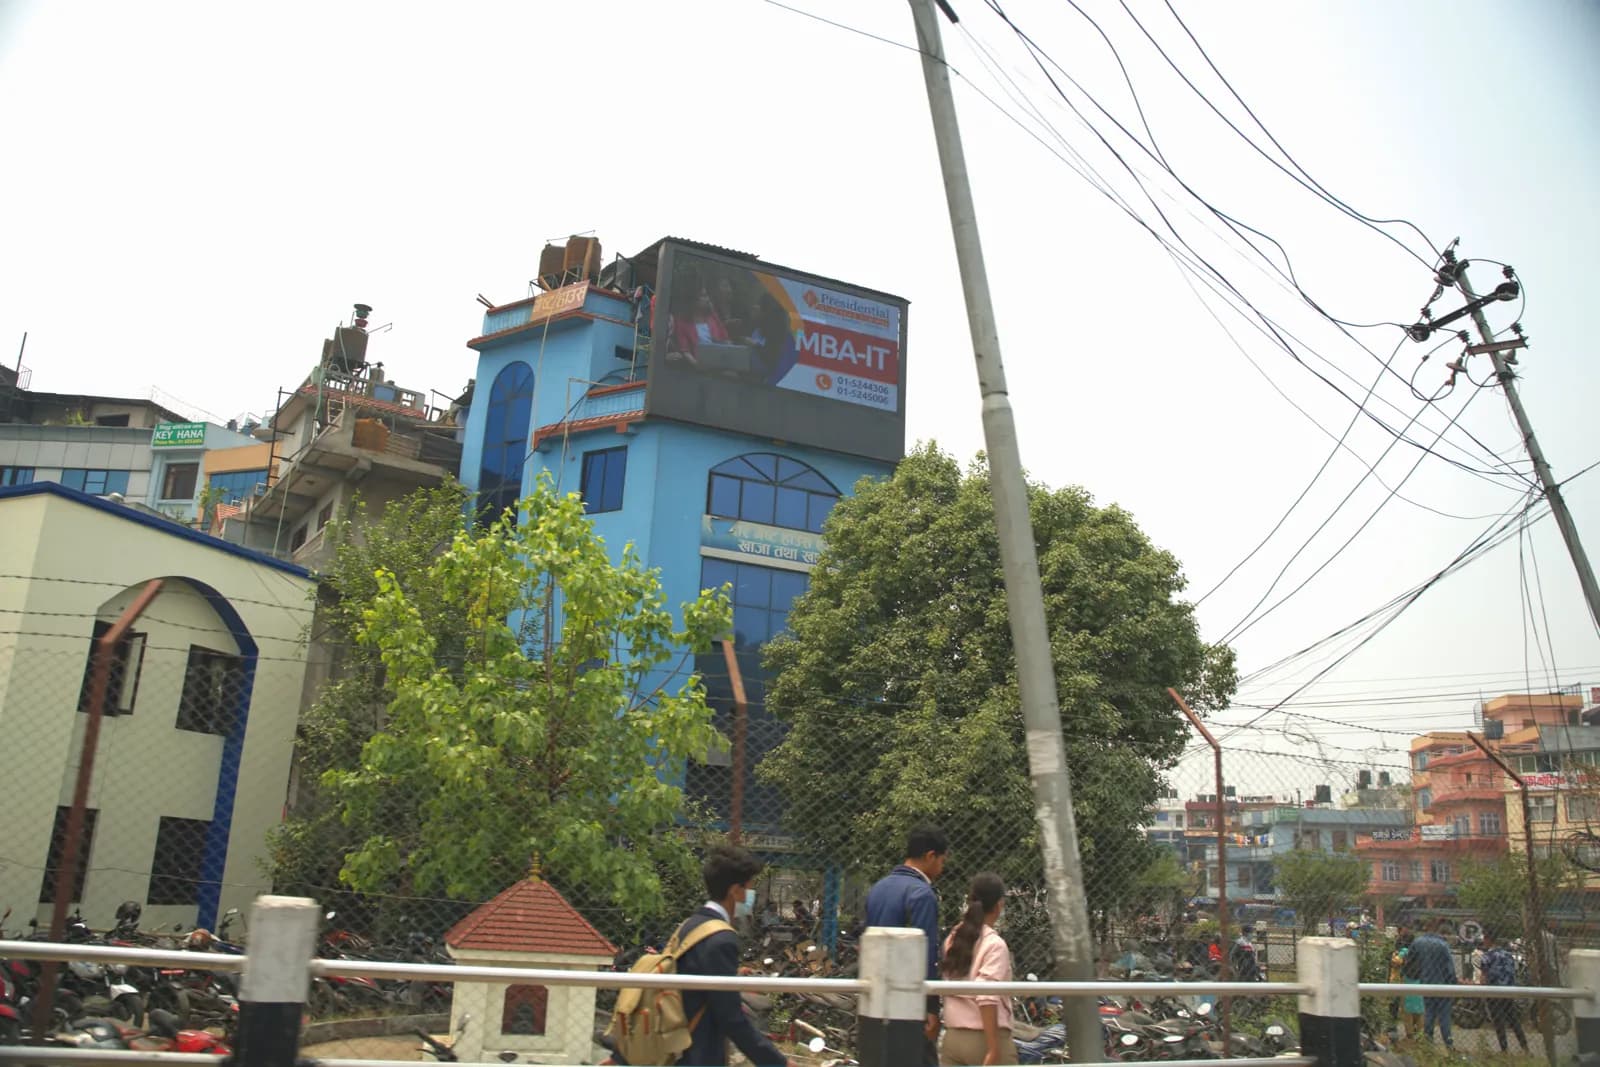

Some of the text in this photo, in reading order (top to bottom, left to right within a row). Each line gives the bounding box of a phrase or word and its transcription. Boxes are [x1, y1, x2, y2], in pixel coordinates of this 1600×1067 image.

[822, 294, 890, 319] Presidential
[795, 328, 891, 371] MBA-IT
[837, 376, 889, 395] 01-5244306
[155, 429, 204, 440] KEY HANA
[738, 541, 771, 556] खाजा
[774, 545, 798, 561] तथा
